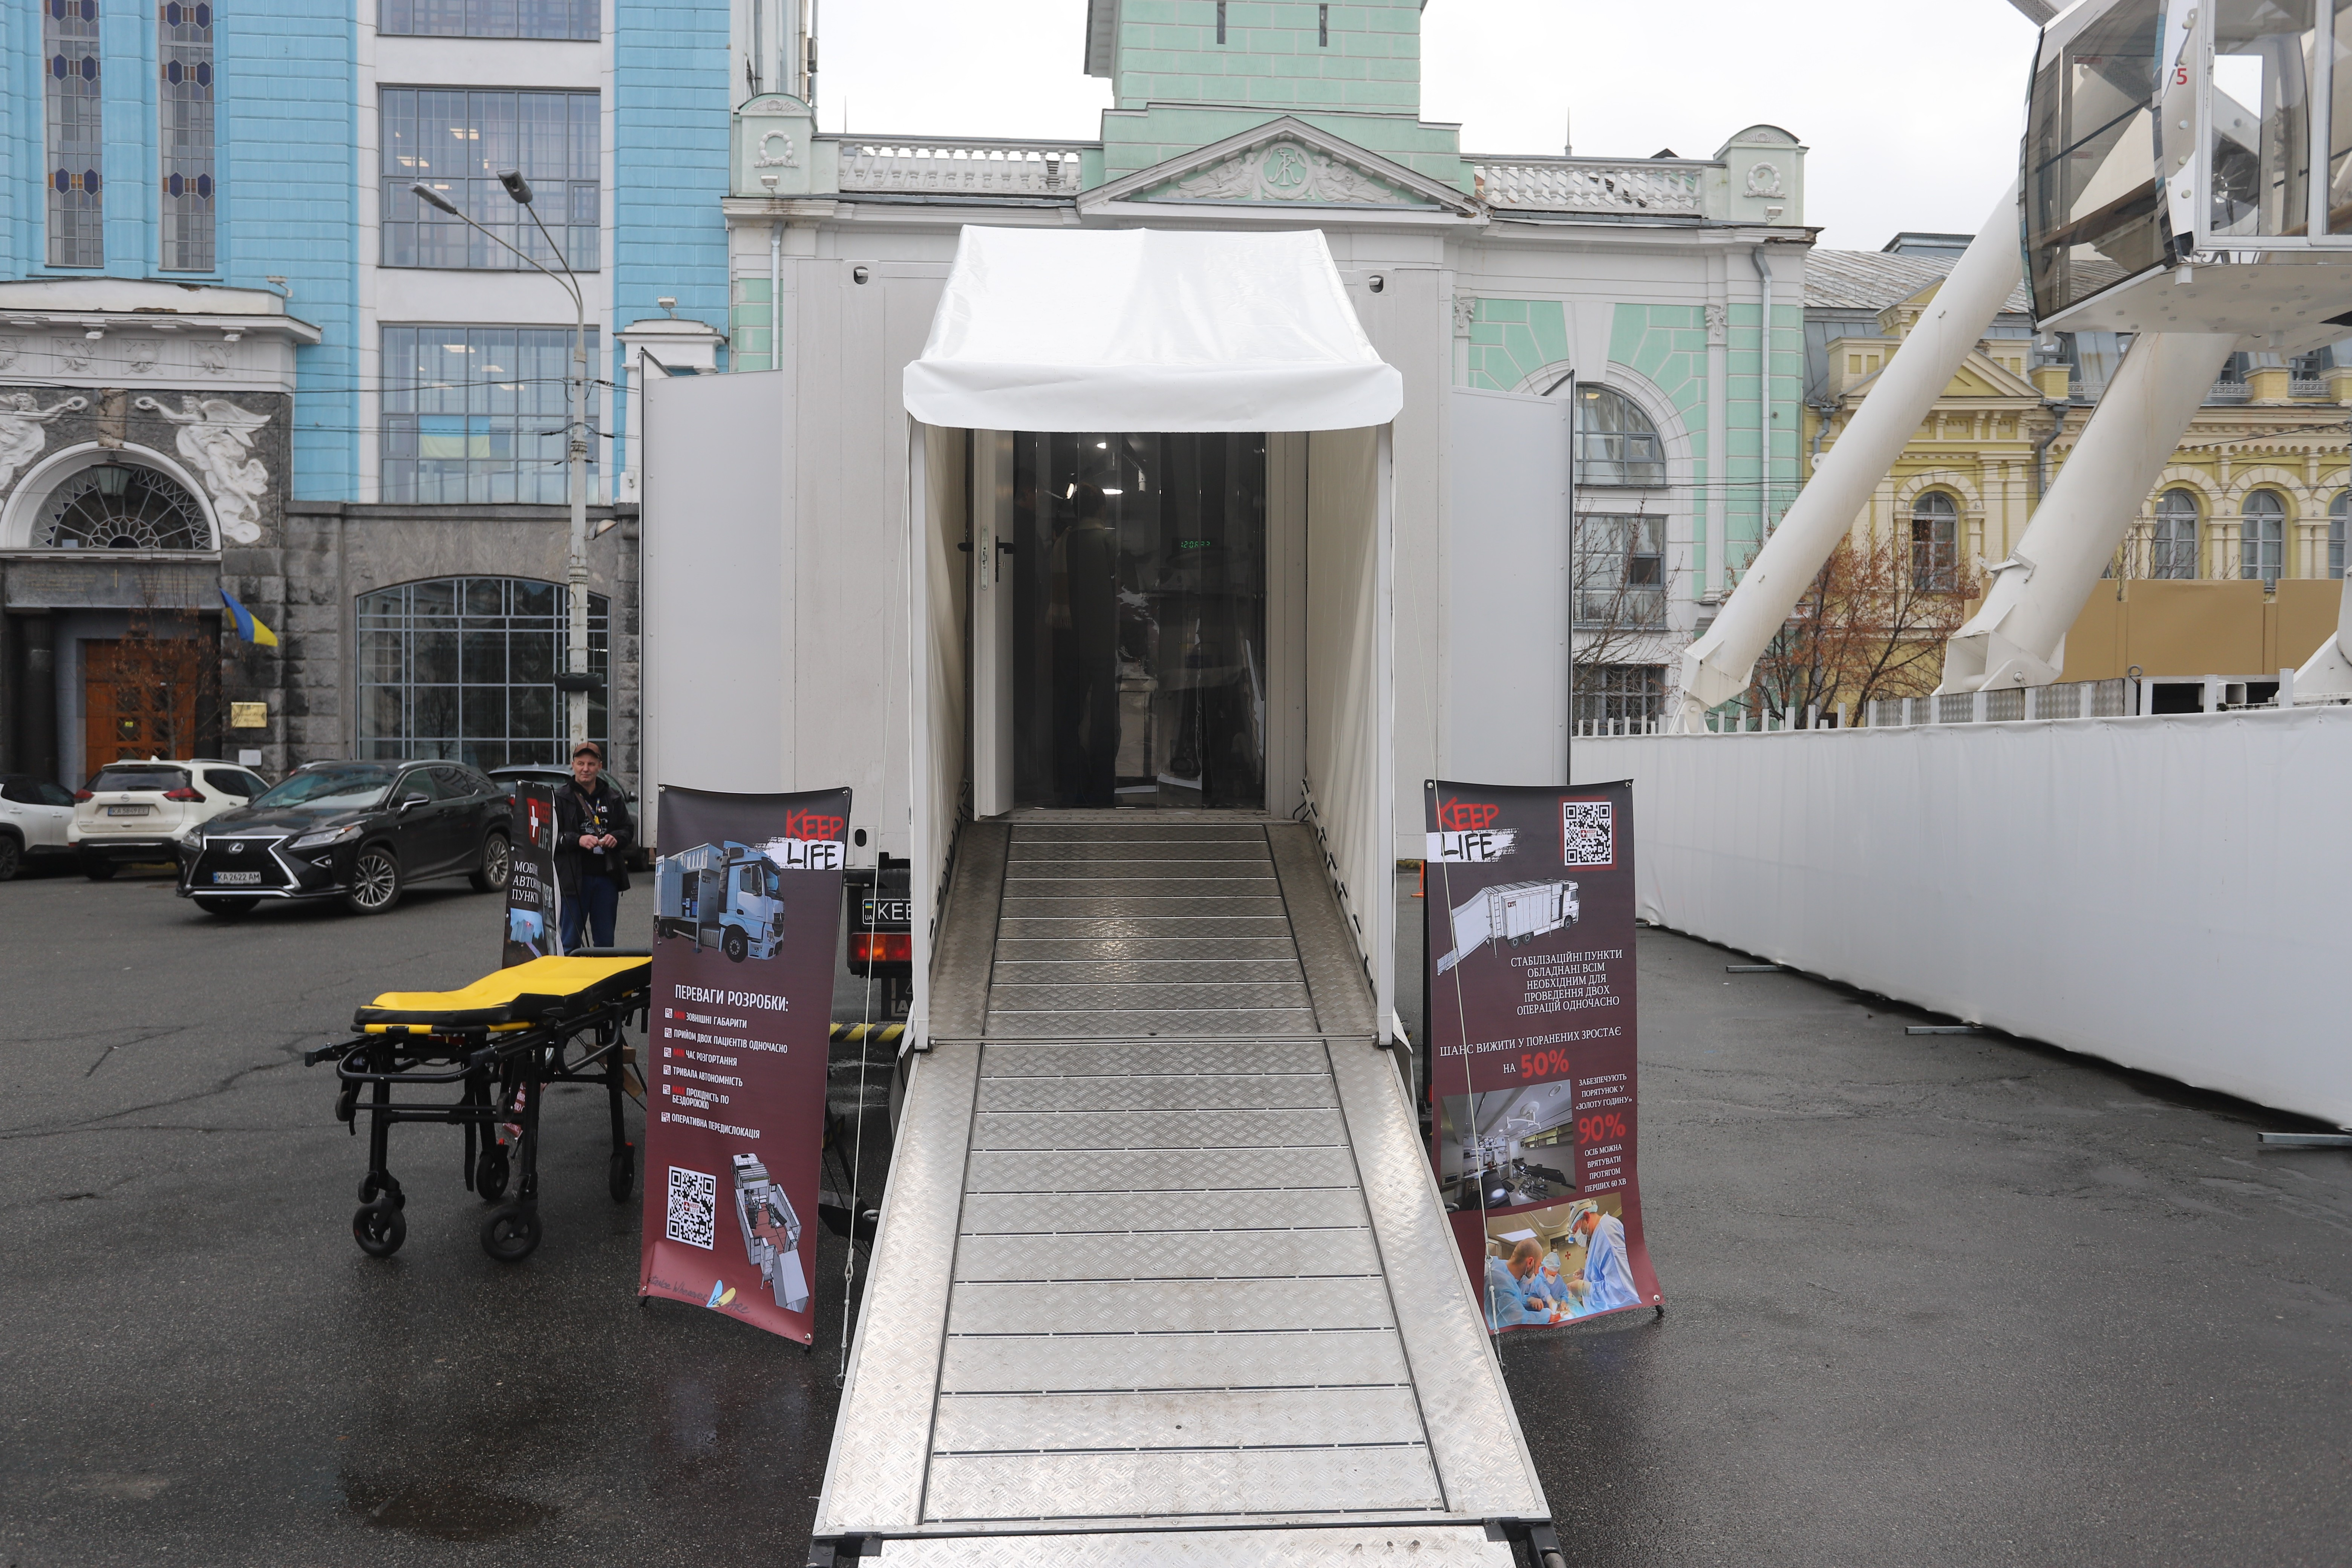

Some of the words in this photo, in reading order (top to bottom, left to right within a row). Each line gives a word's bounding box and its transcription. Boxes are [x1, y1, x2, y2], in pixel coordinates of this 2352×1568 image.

[2176, 68, 2187, 85] 5
[1435, 796, 1500, 831] KEEP
[786, 808, 844, 842] KEEP
[1441, 833, 1496, 861] LIFE
[787, 842, 837, 870] LIFE
[1511, 951, 1582, 967] СТАБІЛІЗАЦІЙНІ
[1584, 949, 1622, 961] ПУНКТИ
[1527, 964, 1580, 978] ОБЛАДНАНІ
[1582, 962, 1605, 972] ВСІМ
[1527, 975, 1586, 990] НЕОБХІДНИМ
[1588, 973, 1606, 985] ДЛЯ
[675, 984, 724, 1004] ПЕРЕВАГИ
[727, 991, 789, 1012] РОЗРОБКИ:
[1524, 988, 1583, 1002] ПРОВЕДЕННЯ
[1585, 985, 1610, 997] ДВОХ
[1517, 1000, 1560, 1015] ОПЕРАЦІЙ
[1563, 996, 1620, 1012] ОДНОЧАСНО
[686, 1012, 712, 1024] ЗОВНІШНІ
[714, 1016, 747, 1029] ГАБАРИТИ
[674, 1029, 696, 1041] ПРИЙОМ
[697, 1033, 712, 1044] ДВОХ
[714, 1036, 747, 1049] ПАЦІЄНТІВ
[749, 1040, 788, 1054] ОДНОЧАСНО
[1440, 1044, 1474, 1057] ШАНС
[1476, 1039, 1516, 1054] ВИЖИТИ
[1518, 1038, 1524, 1048] У
[1527, 1031, 1580, 1047] ПОРАНЕНИХ
[1582, 1026, 1622, 1039] ЗРОСТАЄ
[686, 1050, 696, 1060] ЧАС
[697, 1052, 737, 1066] РОЗГОРТАННЯ
[1503, 1063, 1516, 1074] НА
[1521, 1049, 1569, 1078] 50%
[673, 1066, 698, 1079] ТРИВАЛА
[699, 1071, 743, 1087] АВТОНОМНІСТЬ
[1579, 1073, 1627, 1086] ЗАБЕЗПЕЧУЮТЬ
[686, 1088, 719, 1103] ПРОХІДНІСТЬ
[720, 1095, 729, 1104] ПО
[1581, 1086, 1618, 1098] ПОРЯТУНОК
[672, 1095, 709, 1110] БЕЗДОРІЖЖЮ
[1576, 1099, 1602, 1110] «ЗОЛОТУ
[1603, 1096, 1632, 1107] ГОДИНУ»
[672, 1113, 707, 1129] ОПЕРАТИВНА
[708, 1121, 760, 1139] ПЕРЕДИСЛОКАЦІЯ
[1579, 1112, 1626, 1144] 90%
[1584, 1147, 1598, 1157] ОСІБ
[1599, 1143, 1622, 1155] МОЖНА
[1587, 1155, 1622, 1168] ВРЯТУВАТИ
[1589, 1167, 1621, 1180] ПРОТЯГОМ
[1584, 1182, 1610, 1193] ПЕРШИХ
[1611, 1179, 1618, 1188] 60
[1619, 1178, 1627, 1187] ХВ
